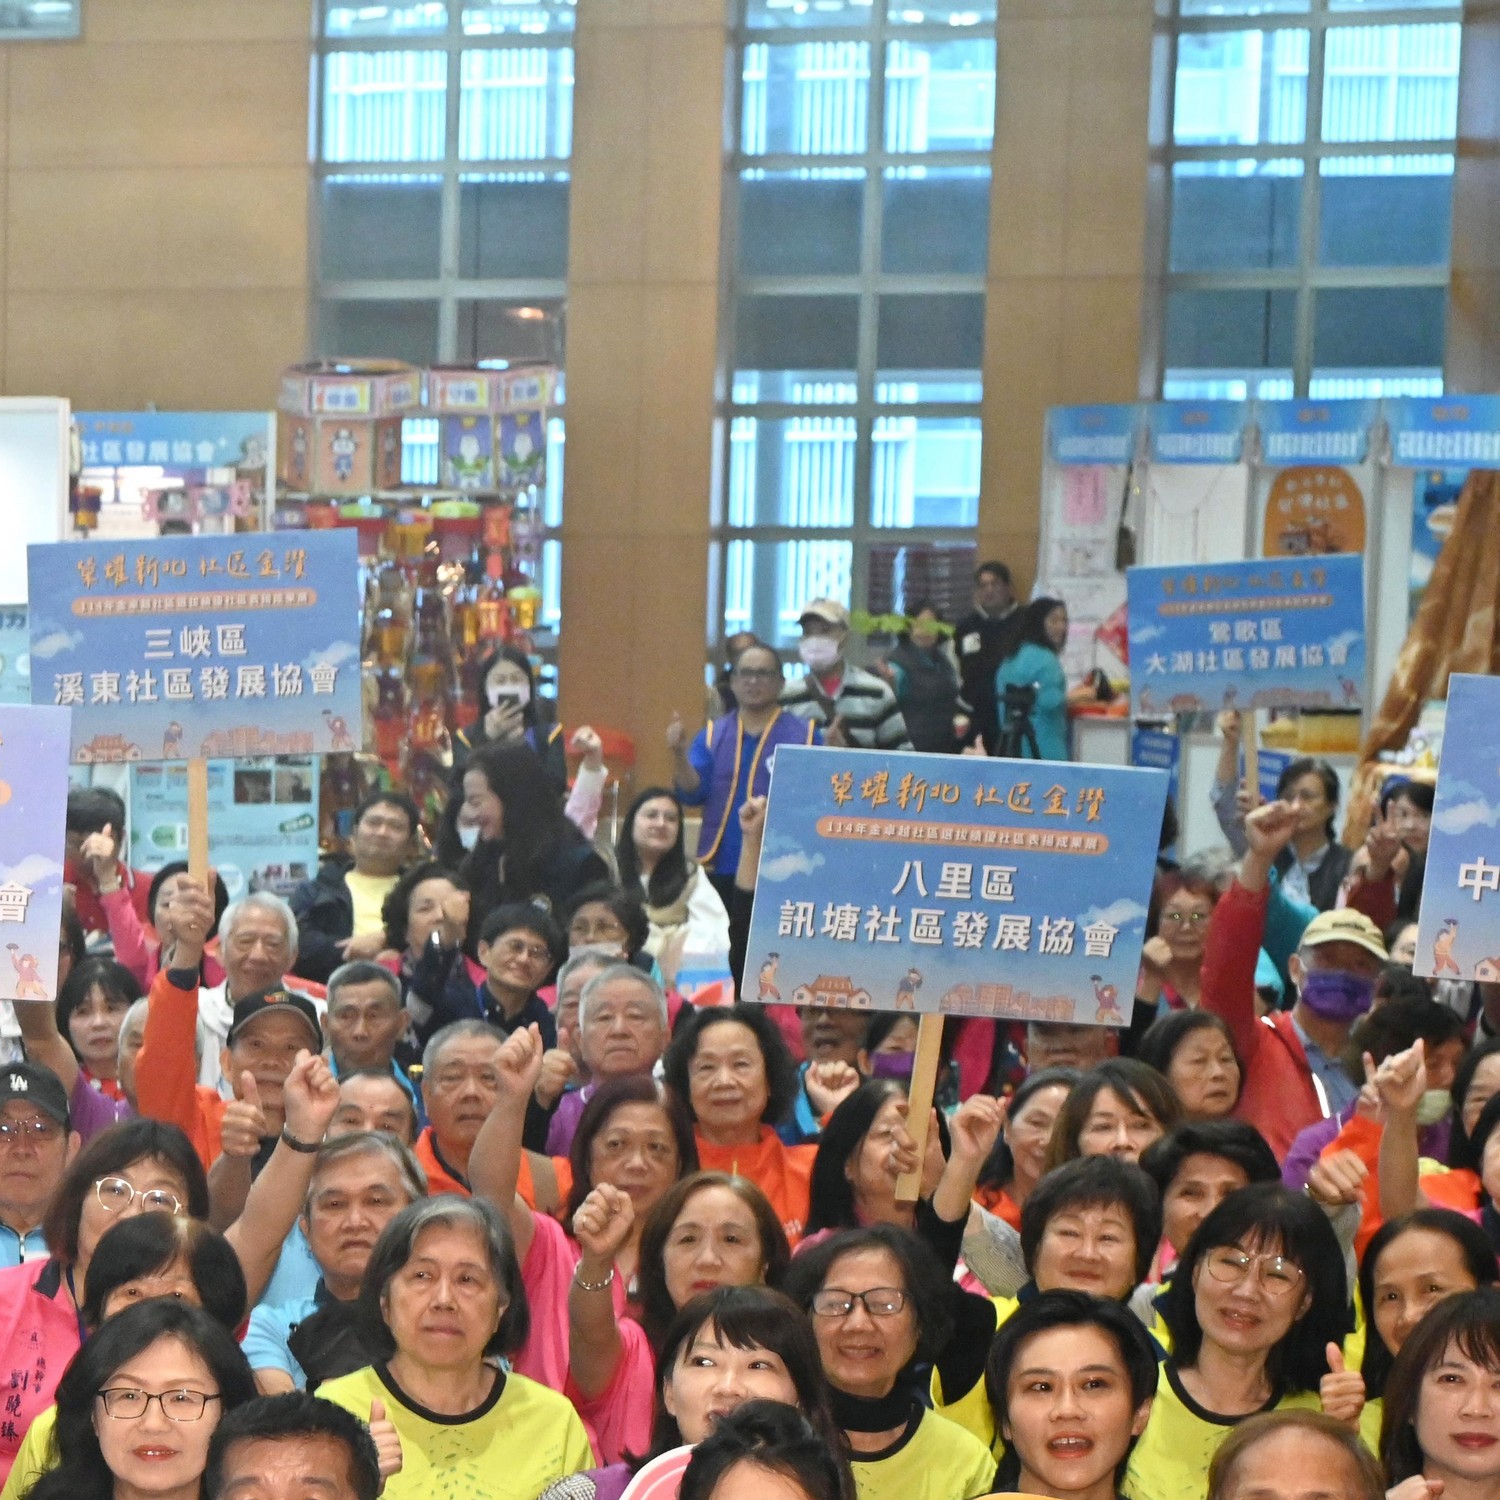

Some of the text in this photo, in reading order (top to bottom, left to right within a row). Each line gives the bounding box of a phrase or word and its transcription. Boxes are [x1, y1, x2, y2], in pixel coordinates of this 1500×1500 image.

[144, 623, 248, 660] 三峽區
[1145, 644, 1350, 676] 大湖社區發展協會
[54, 664, 340, 706] 溪東社區發展協會
[830, 770, 1106, 822] 榮耀新北 社區金讚
[892, 860, 1019, 902] 八里區
[778, 900, 1119, 958] 訊塘社區發展協會
[10, 1073, 28, 1092] LA
